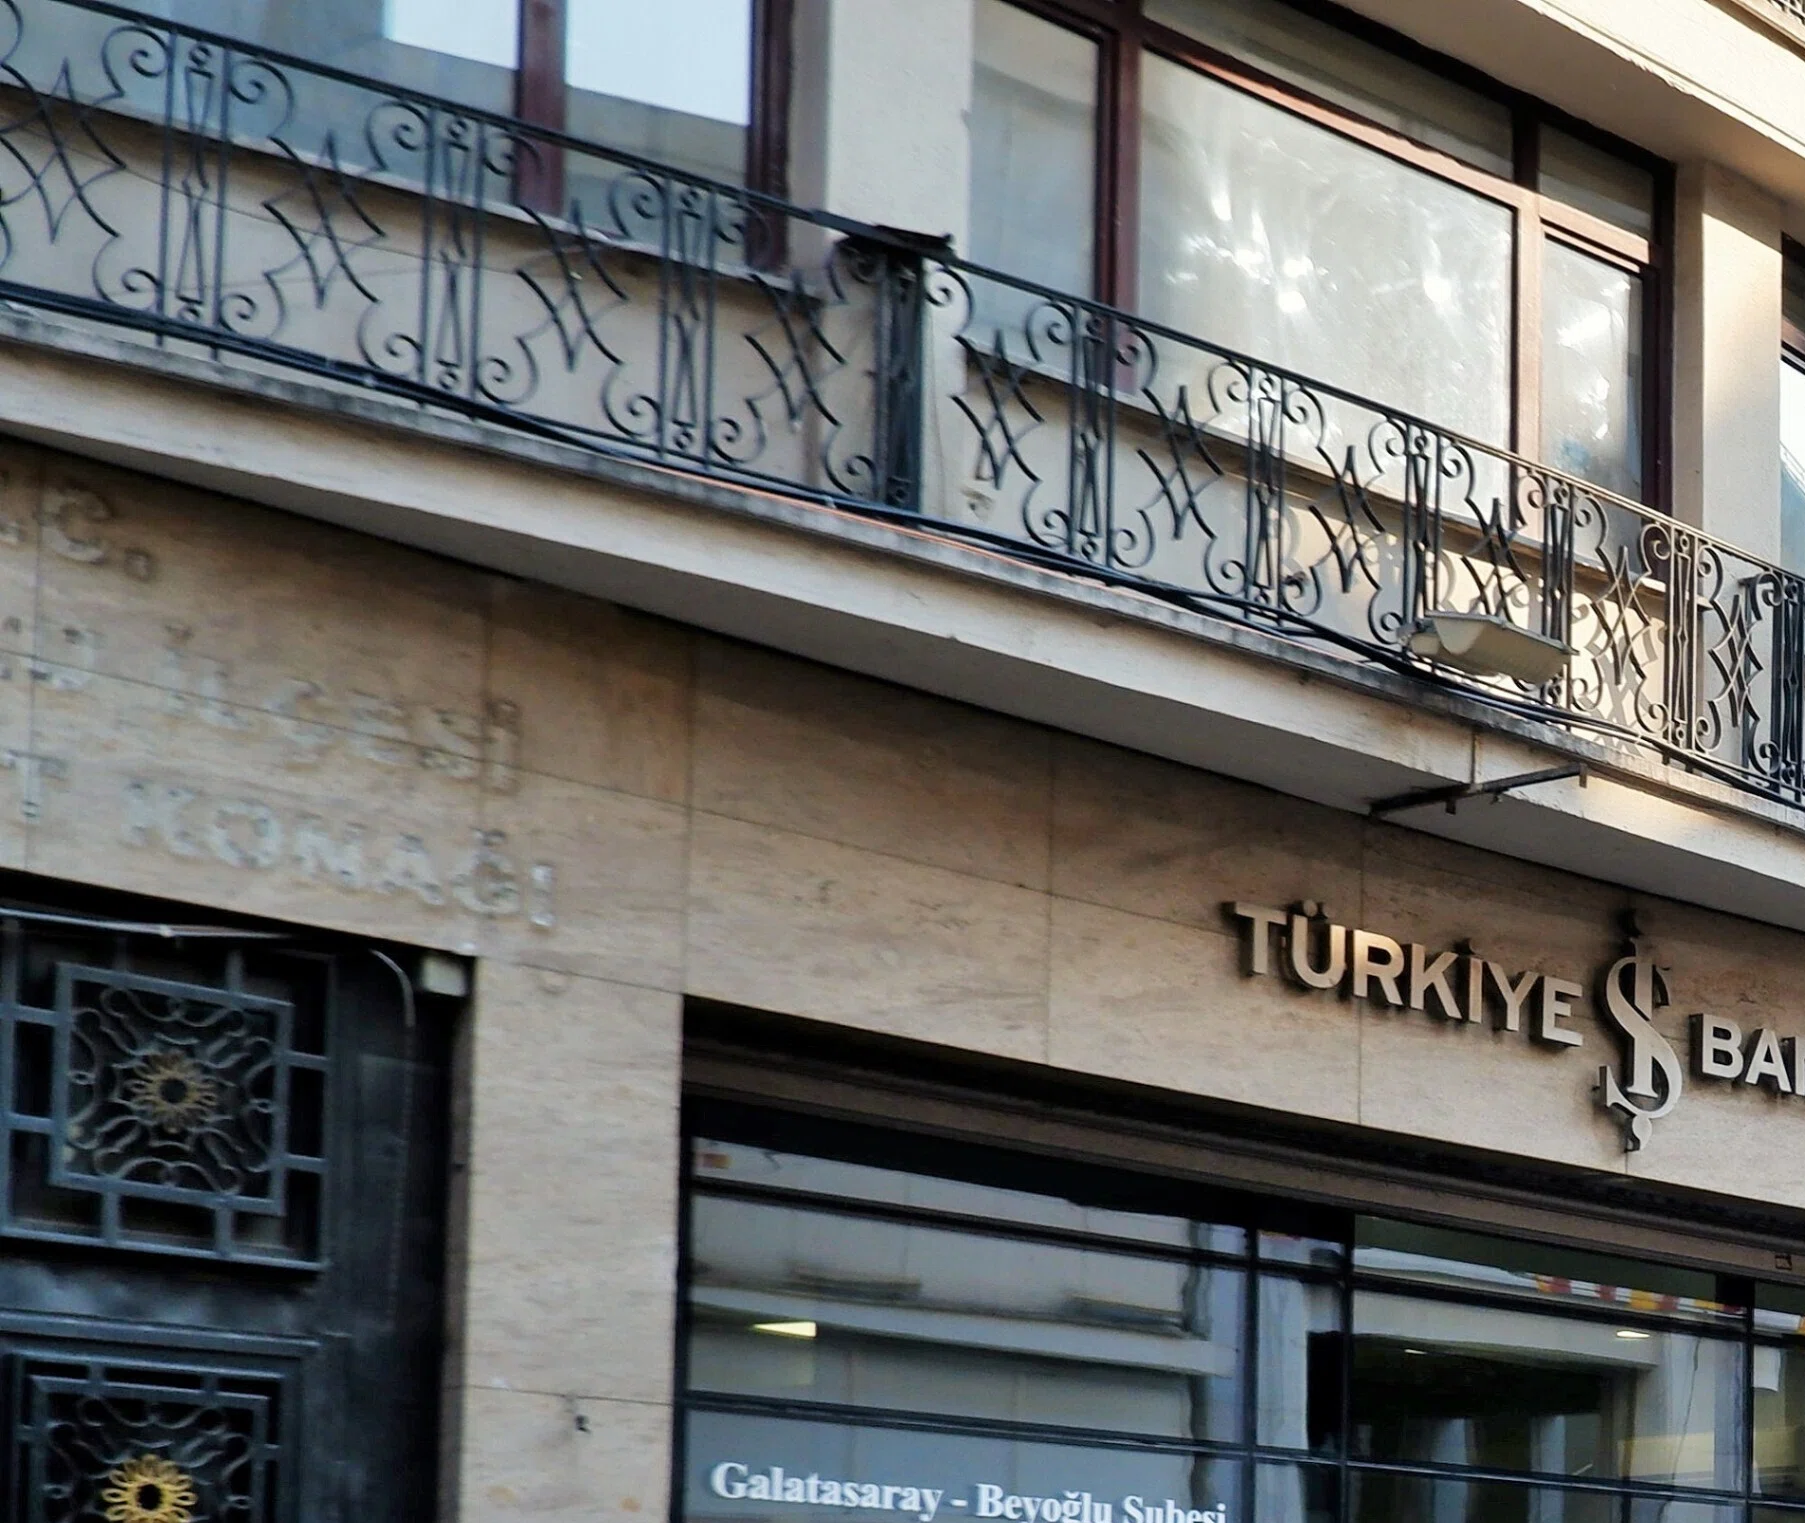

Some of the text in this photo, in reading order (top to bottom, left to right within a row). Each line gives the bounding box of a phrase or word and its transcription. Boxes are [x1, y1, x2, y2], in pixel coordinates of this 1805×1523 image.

[120, 780, 557, 930] KONAĞI
[1230, 899, 1584, 1048] TÜRKİYE
[711, 1461, 944, 1522] Galatasaray
